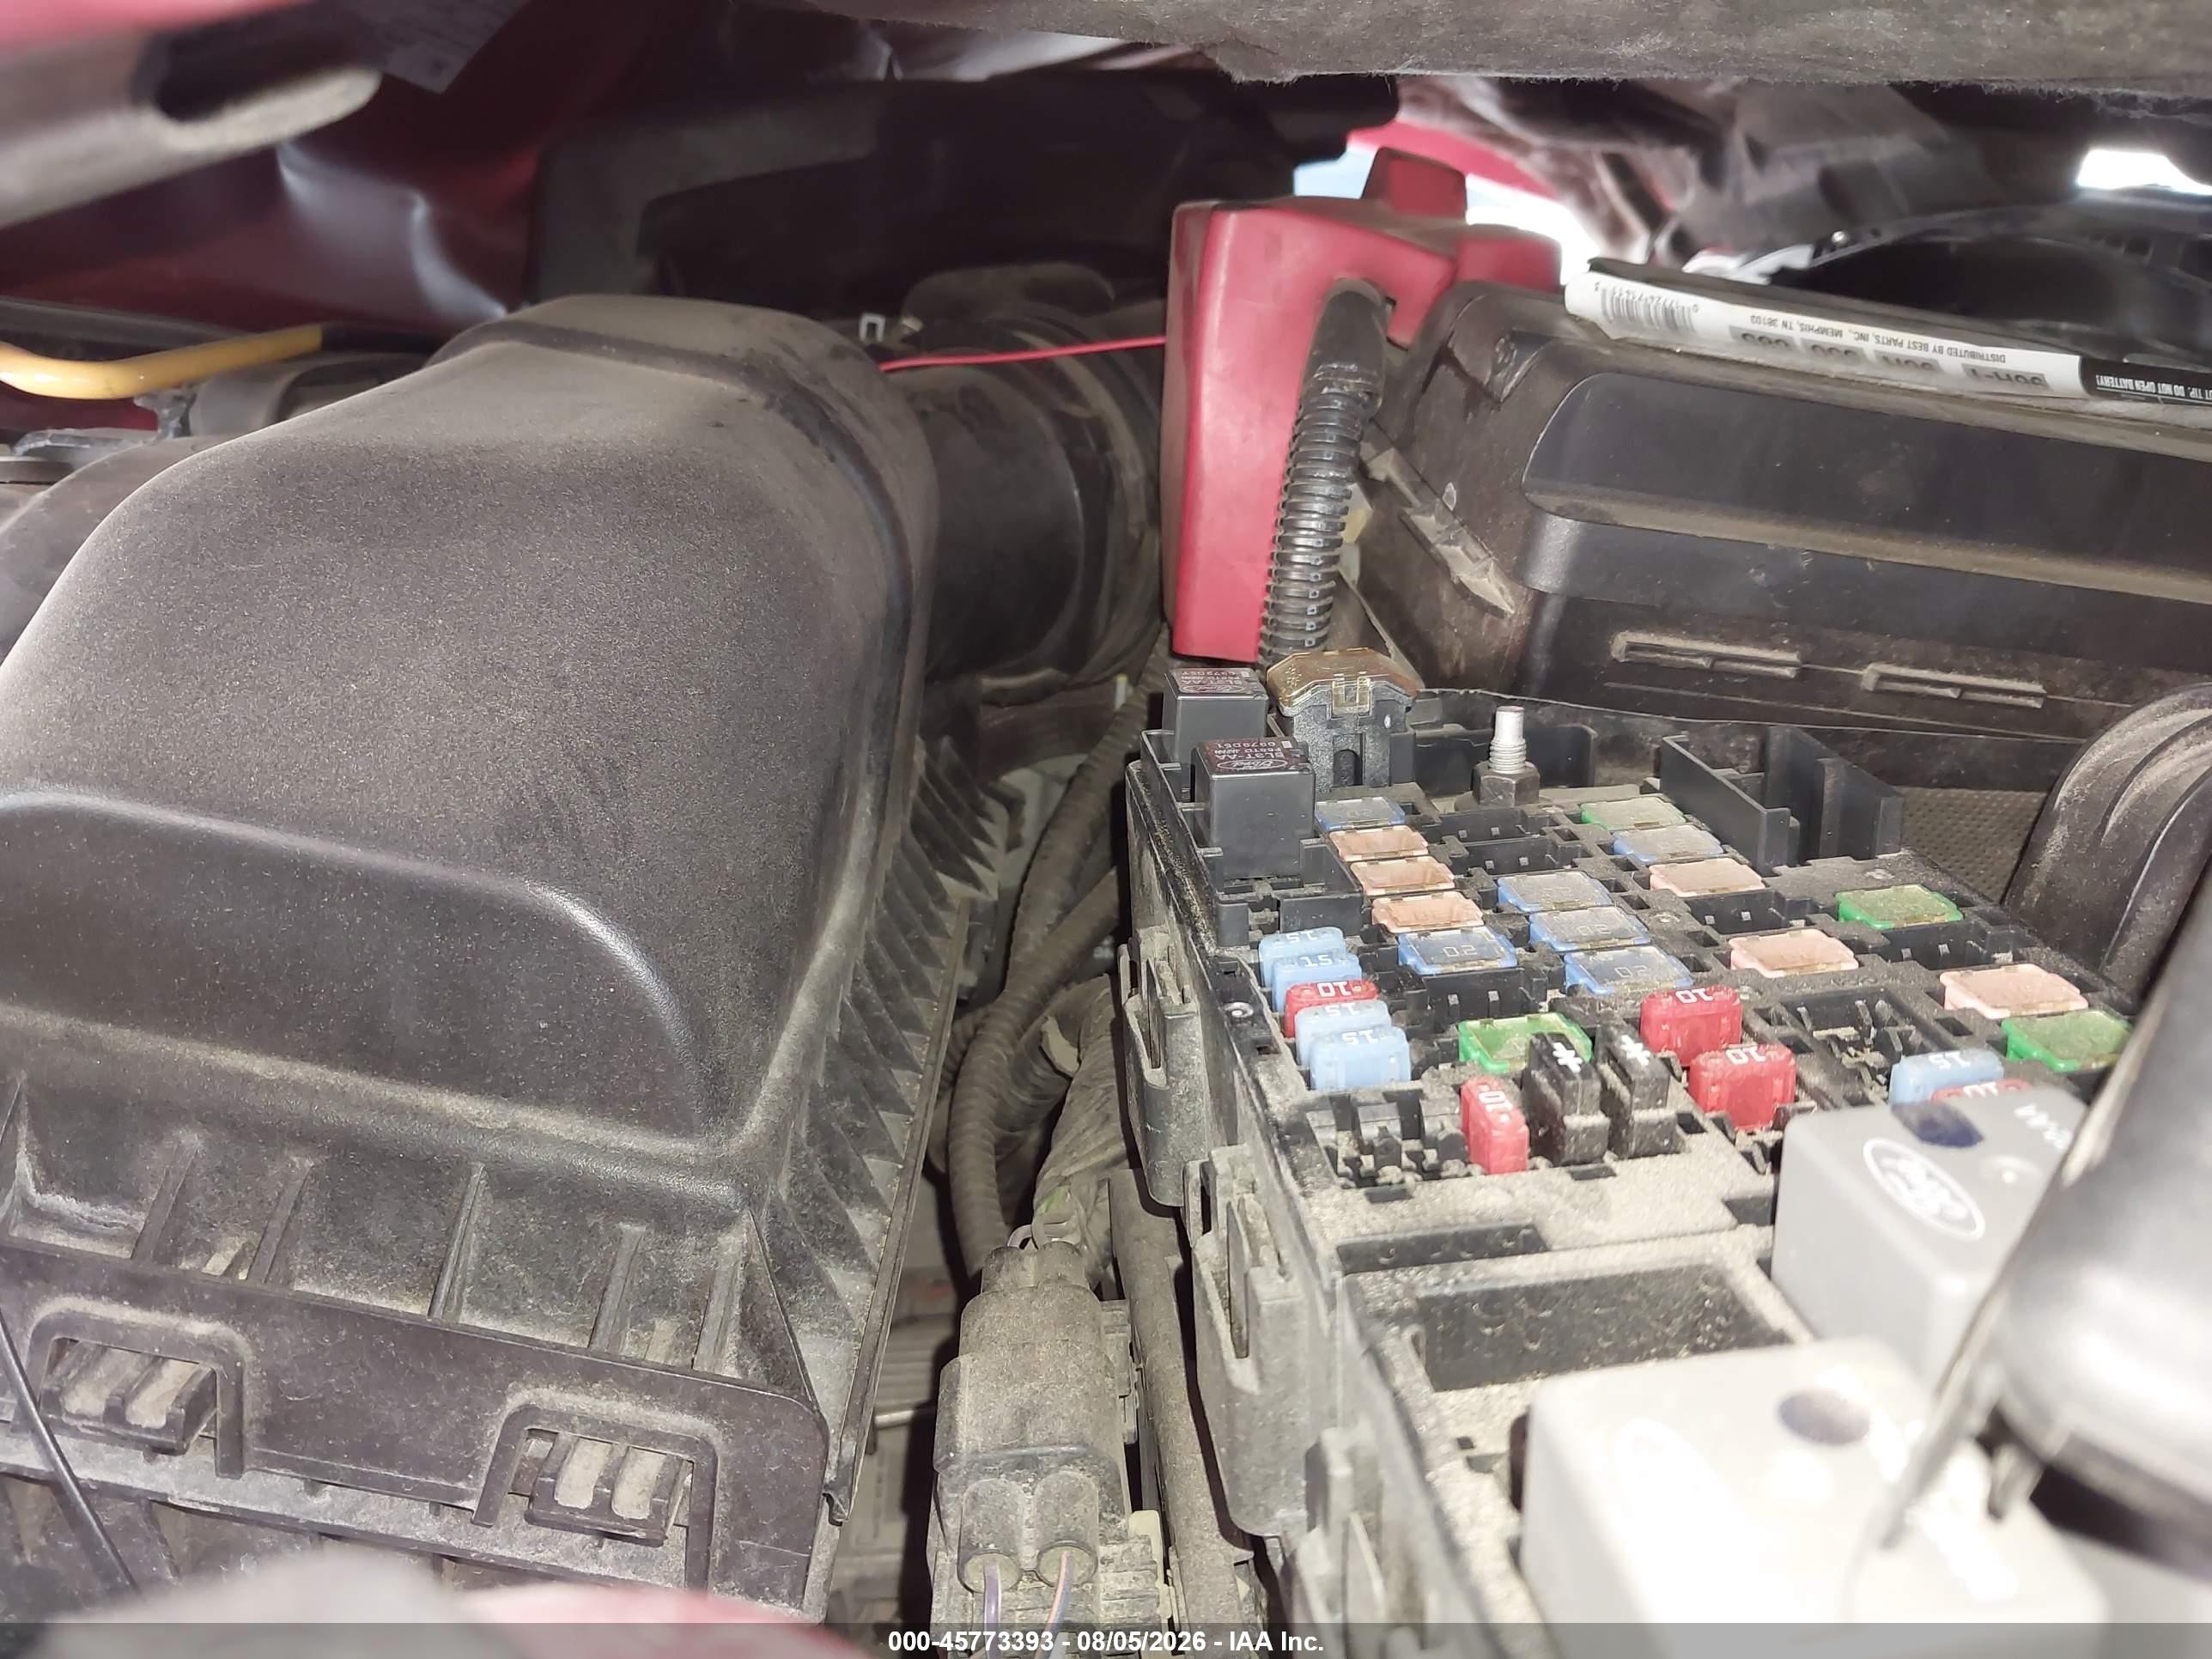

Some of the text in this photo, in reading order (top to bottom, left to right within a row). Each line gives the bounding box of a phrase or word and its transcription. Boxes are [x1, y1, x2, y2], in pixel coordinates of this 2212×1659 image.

[1781, 319, 1794, 331] TN
[1796, 321, 1843, 338] MEMPHIS,
[1872, 334, 1904, 349] PARTS,
[1907, 340, 1929, 353] BEST
[1931, 343, 1943, 356] BY
[1947, 346, 2006, 364] DISTRIBUTED
[2095, 374, 2135, 390] BATTERY!
[2135, 380, 2156, 393] OPEN
[2157, 382, 2173, 395] NOT
[2173, 384, 2185, 397] DO
[2187, 386, 2203, 399] TIP.
[1286, 930, 1319, 943] 15
[1443, 945, 1478, 957] 20
[1300, 954, 1333, 967] 15
[1316, 981, 1352, 998] 10
[1675, 987, 1714, 1004] 10
[1324, 1002, 1360, 1017] 15
[1341, 1029, 1379, 1045] 15
[1725, 1045, 1766, 1065] 10
[1929, 1051, 1972, 1070] 15
[1478, 1089, 1513, 1113] 10
